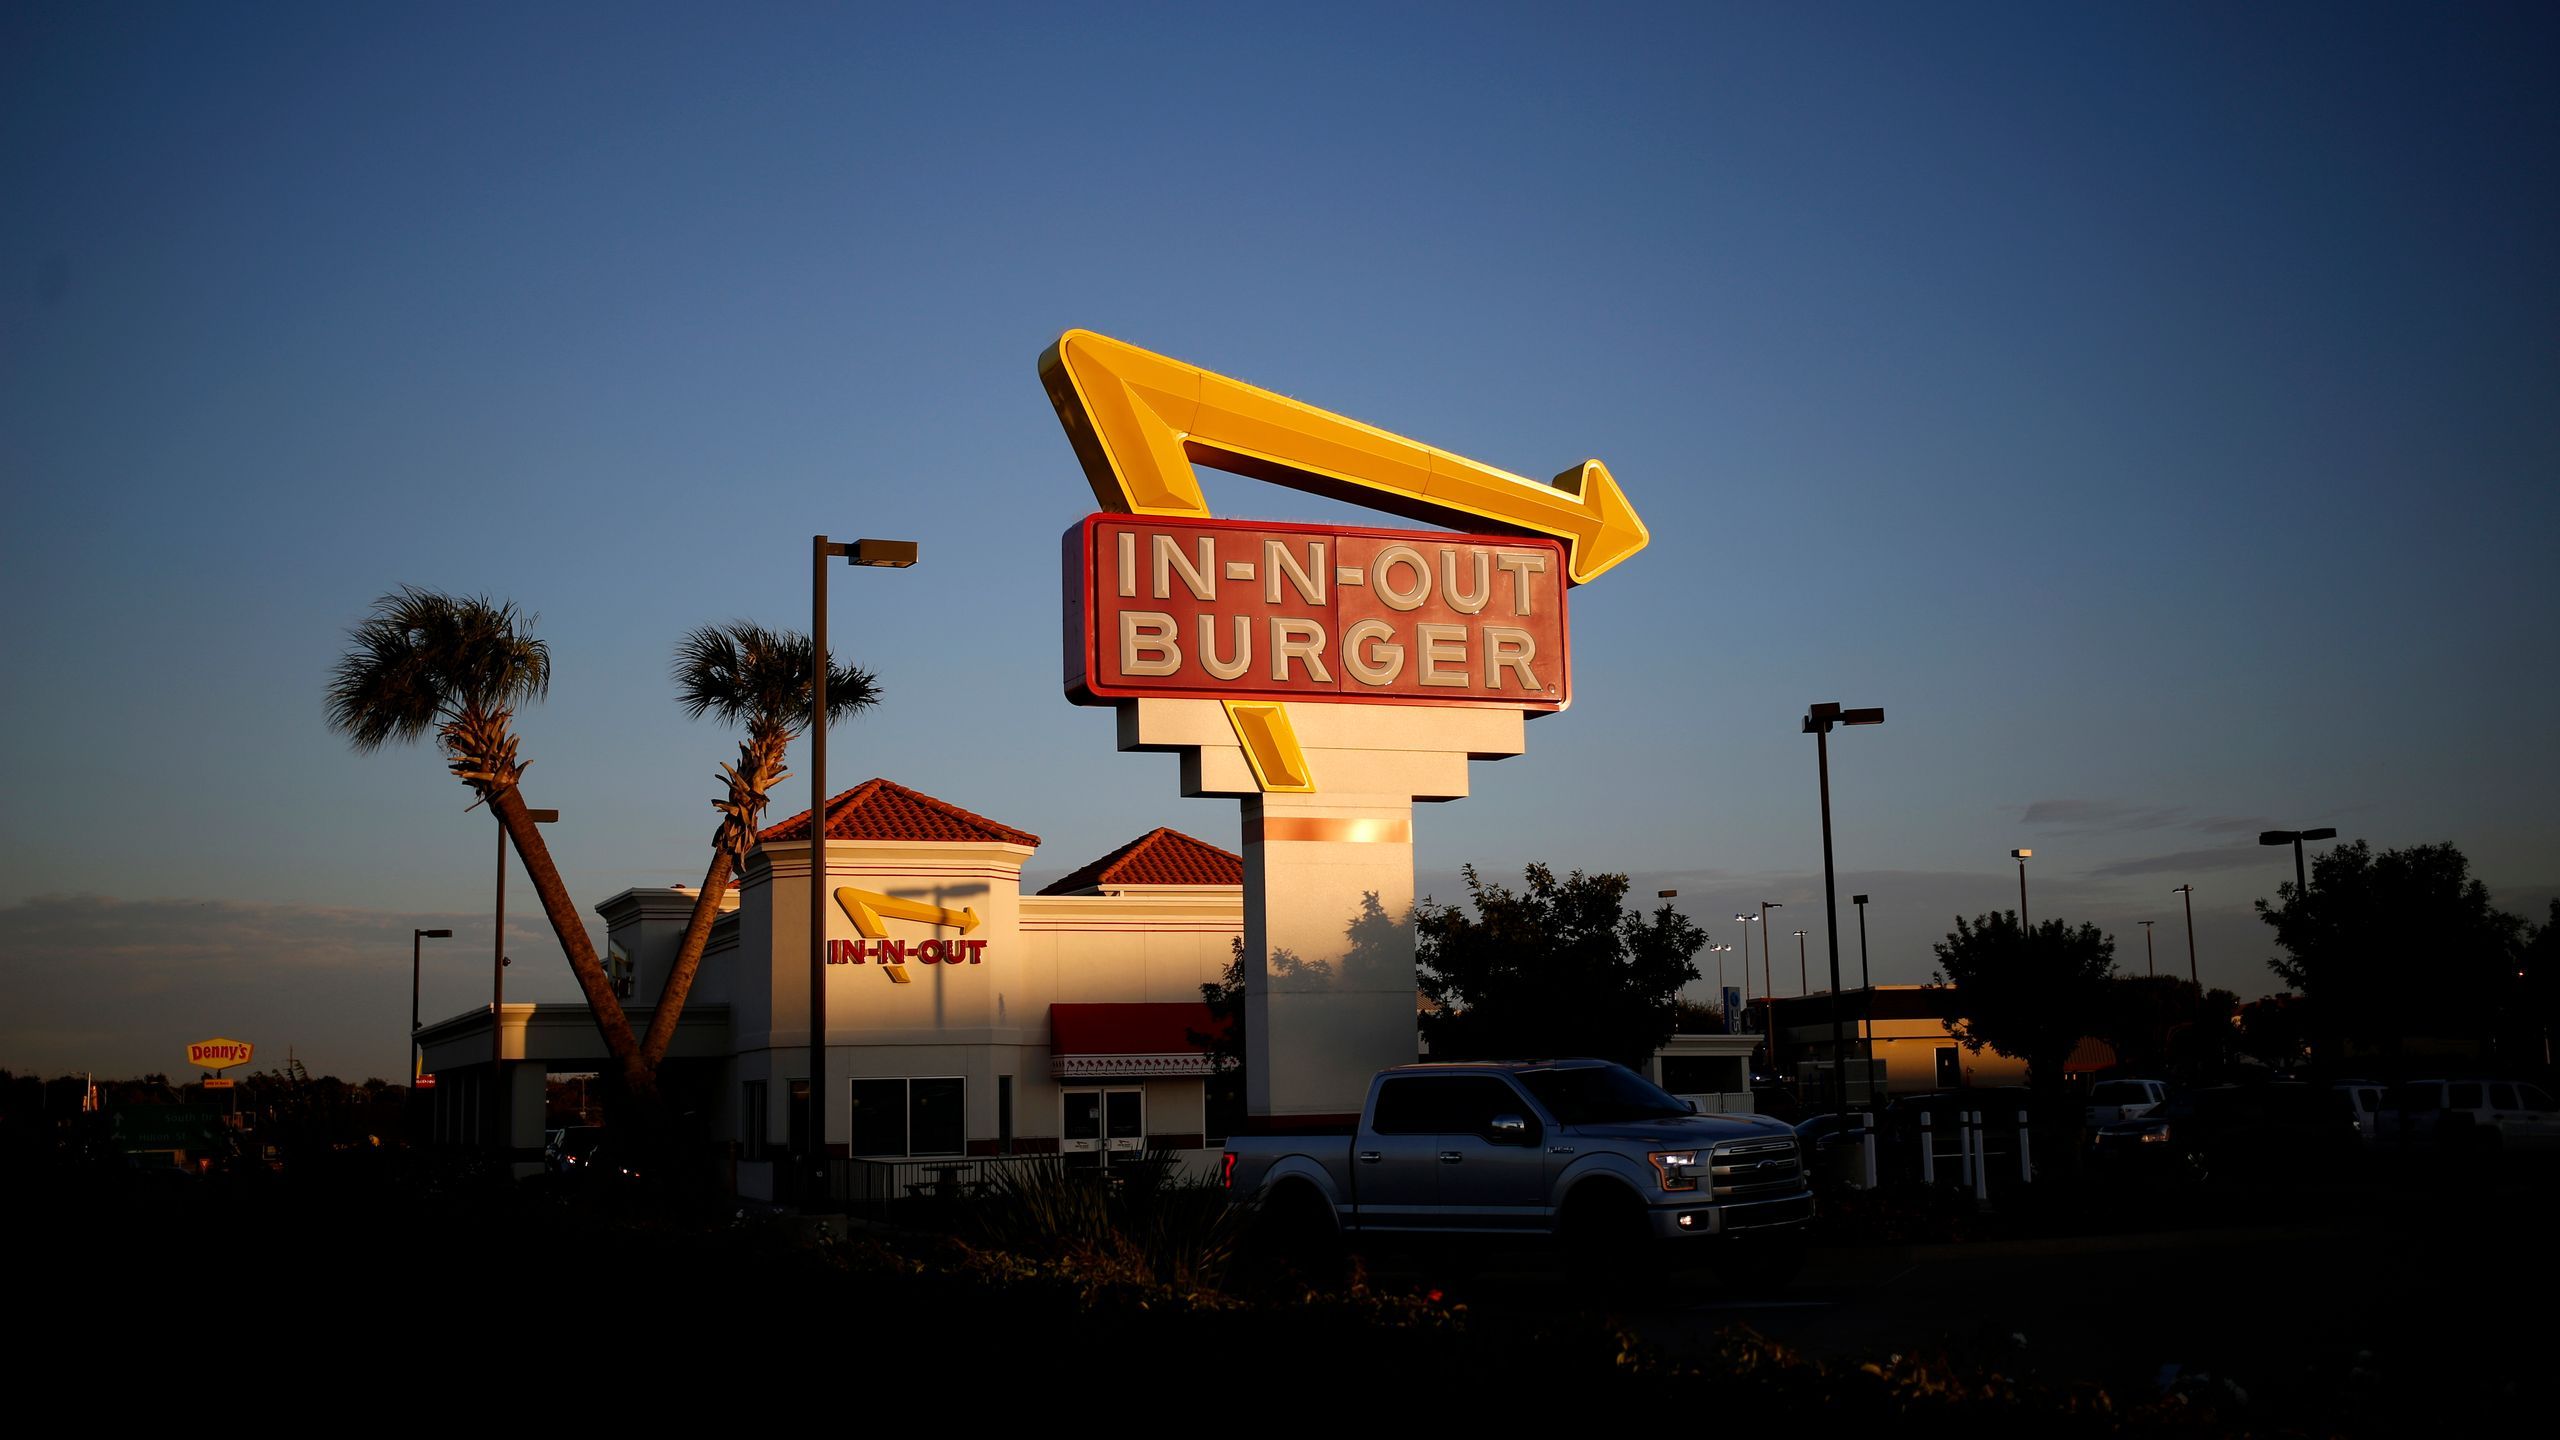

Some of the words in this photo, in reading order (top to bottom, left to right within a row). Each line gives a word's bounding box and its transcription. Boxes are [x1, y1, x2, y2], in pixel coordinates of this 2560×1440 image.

[1117, 531, 1545, 616] IN-N-OUT
[1119, 610, 1543, 692] BURGER
[827, 939, 987, 965] IN-N-OUT
[191, 1044, 248, 1061] Denny's
